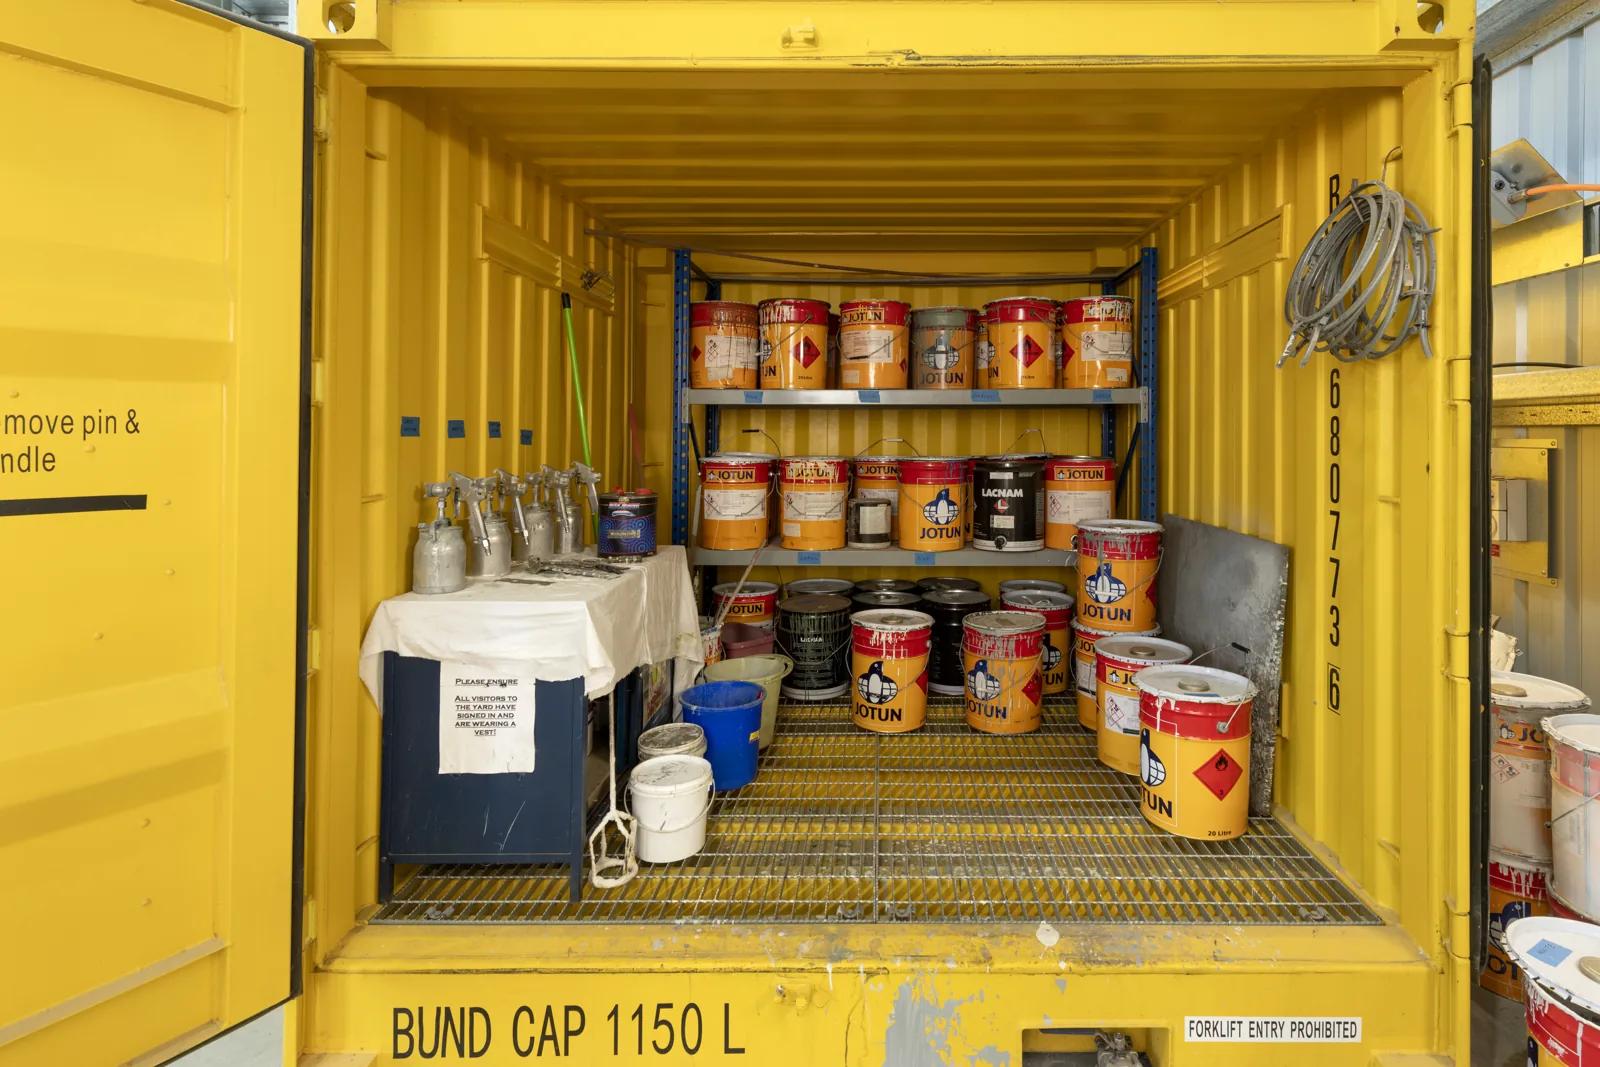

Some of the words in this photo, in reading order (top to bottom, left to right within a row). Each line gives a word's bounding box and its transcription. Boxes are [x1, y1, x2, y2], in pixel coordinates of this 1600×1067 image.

[848, 312, 882, 322] JOTUN
[920, 372, 964, 384] JOTUN
[0, 414, 74, 434] move
[82, 409, 117, 440] pin
[125, 408, 140, 434] &
[0, 446, 56, 473] ndle
[718, 471, 753, 480] JOTUN
[796, 468, 831, 477] JOTUN
[865, 466, 897, 474] JOTUN
[1067, 470, 1103, 479] JOTUN
[982, 488, 1023, 497] LACNAM
[920, 527, 960, 539] JOTUN
[728, 604, 762, 614] JOTUN
[1082, 603, 1132, 622] JOTUN
[1080, 640, 1095, 653] JOT
[455, 678, 485, 686] PLEASE
[1044, 671, 1064, 686] TUN
[1330, 668, 1339, 710] 6
[855, 702, 902, 722] JOTUN
[966, 699, 1006, 719] JOTUN
[1141, 785, 1172, 818] TUN
[392, 1006, 491, 1059] BUND
[512, 1004, 586, 1057] CAP
[607, 1002, 703, 1055] 1150
[724, 1002, 745, 1054] L
[1189, 1020, 1243, 1038] FORKLIFT
[1249, 1021, 1284, 1038] ENTRY
[1291, 1021, 1357, 1038] PROHIBITED
